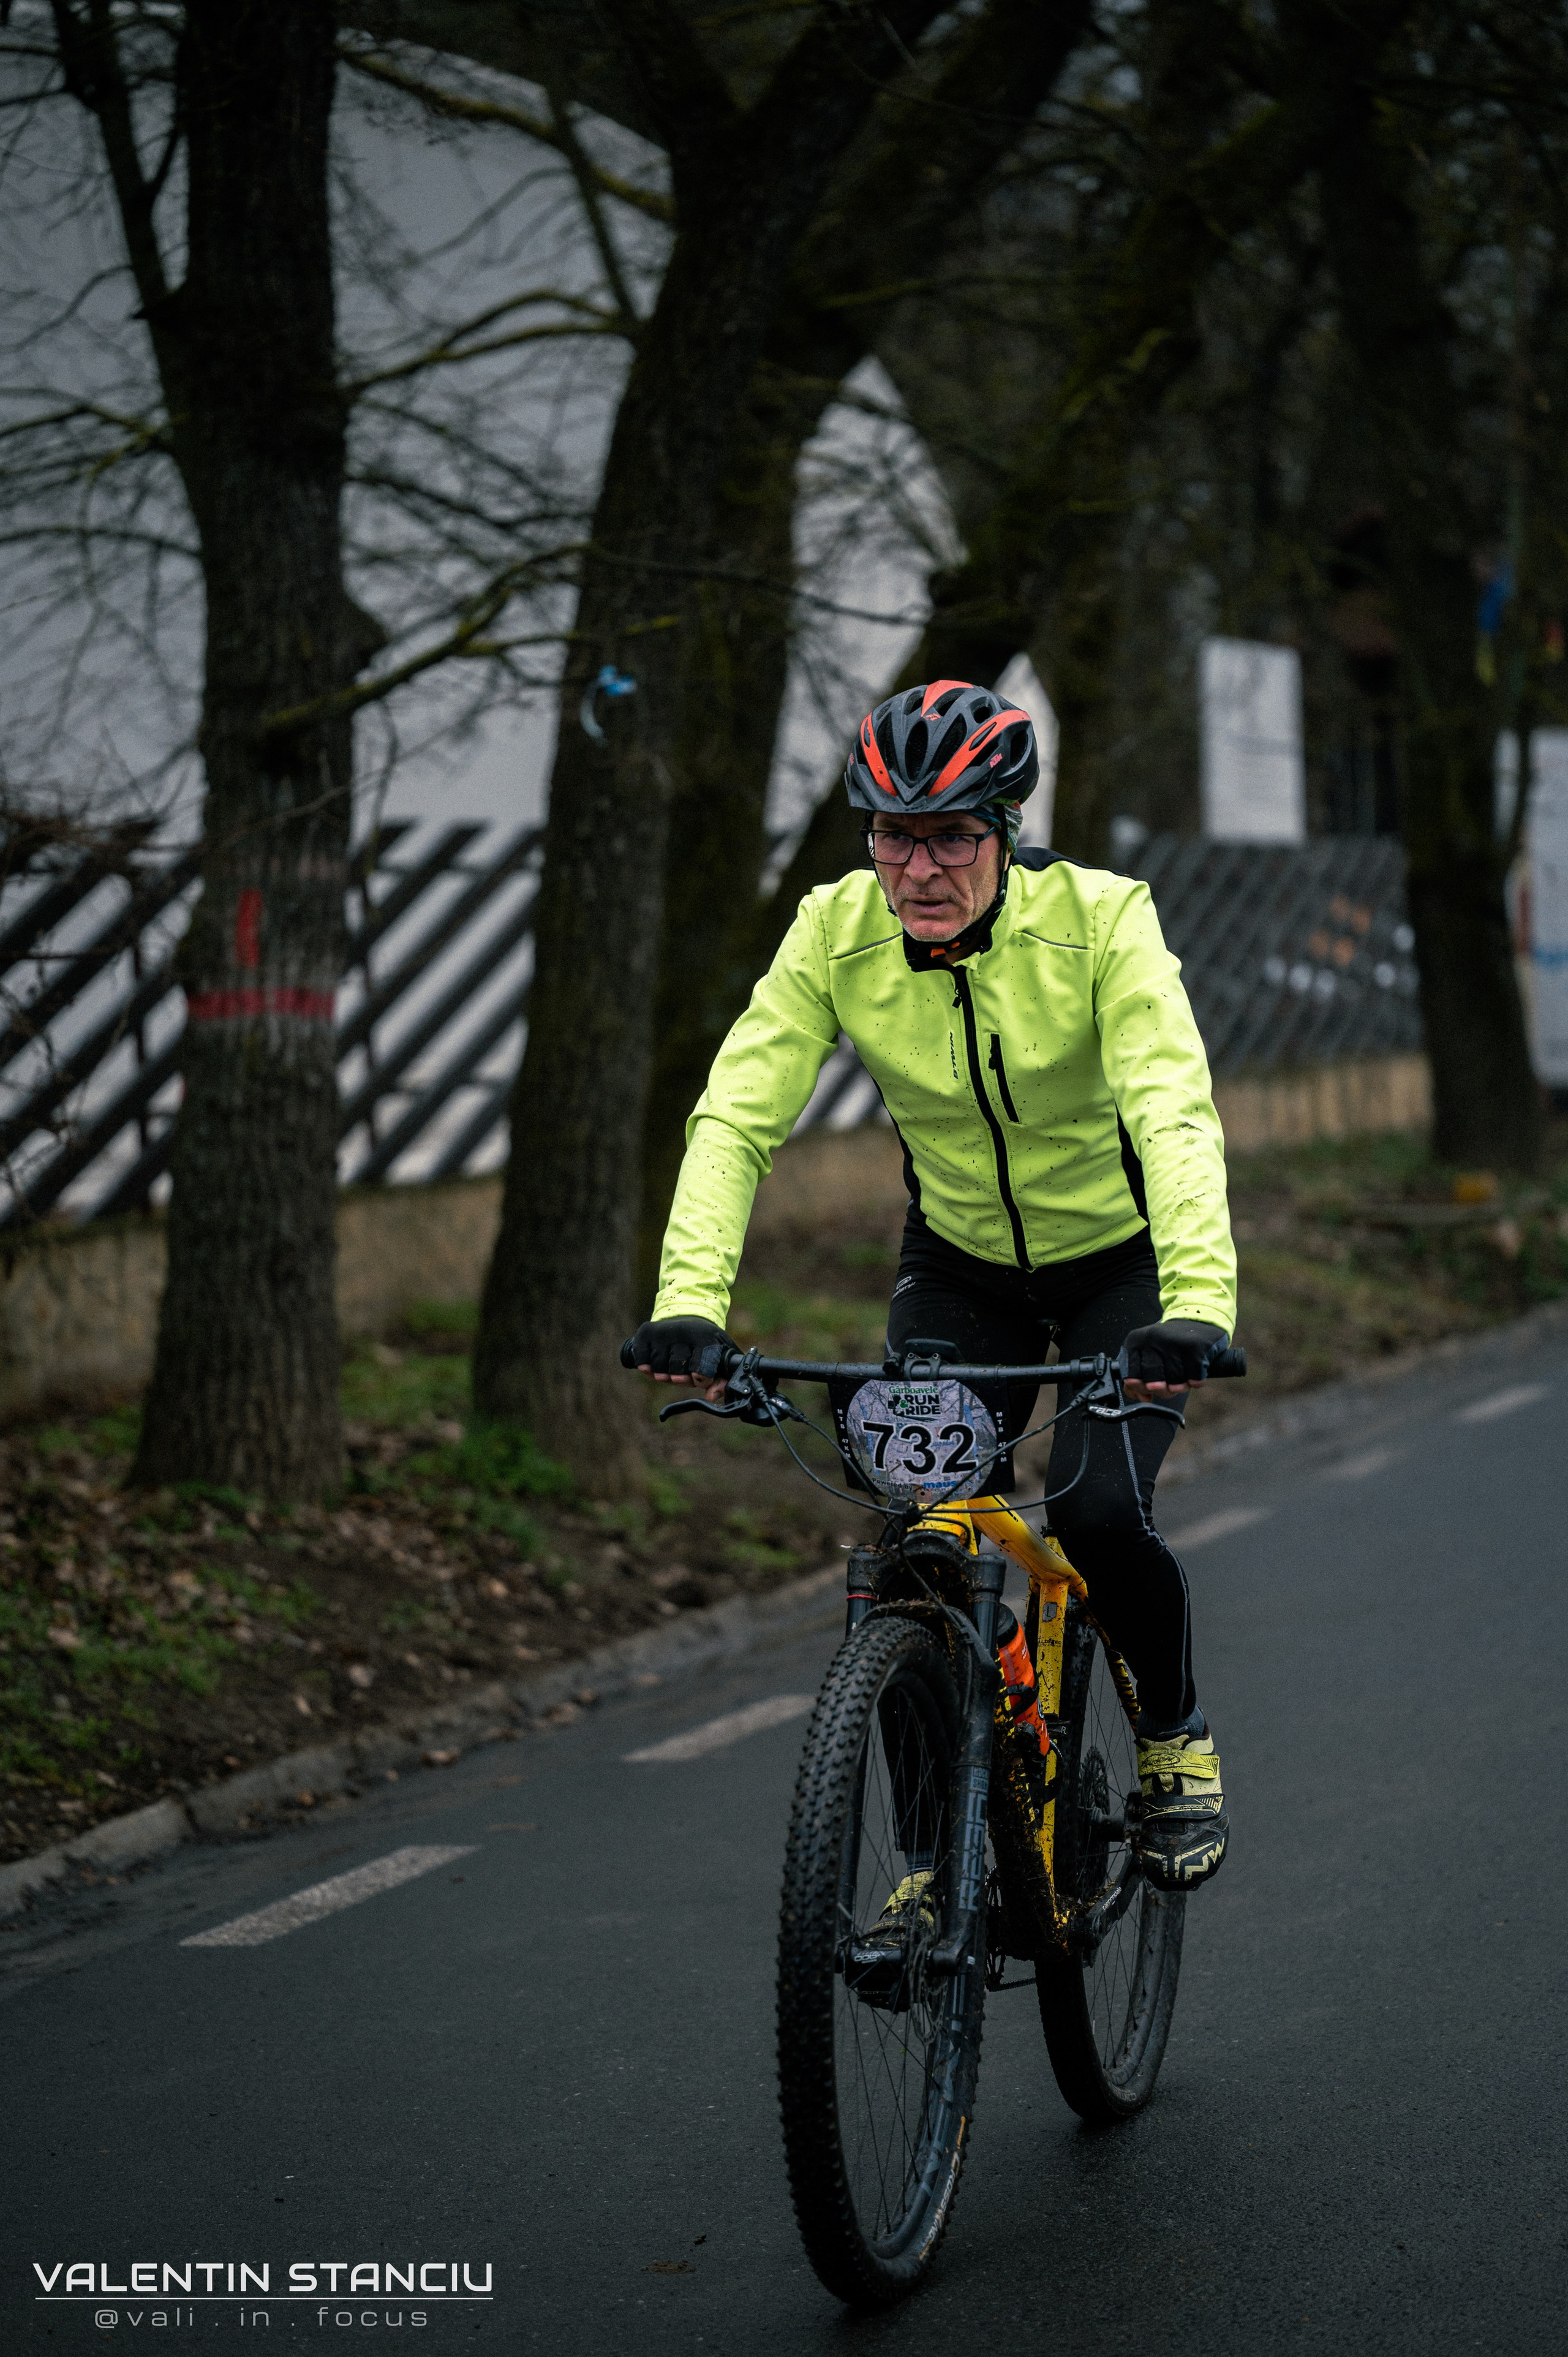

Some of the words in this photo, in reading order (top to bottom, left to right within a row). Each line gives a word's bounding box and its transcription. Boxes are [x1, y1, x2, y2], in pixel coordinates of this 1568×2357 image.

[989, 753, 1003, 769] KTM
[904, 1394, 940, 1405] RUN
[906, 1405, 941, 1415] RIDE
[1089, 1406, 1122, 1416] race
[862, 1421, 978, 1476] 732
[872, 1477, 902, 1488] Powered
